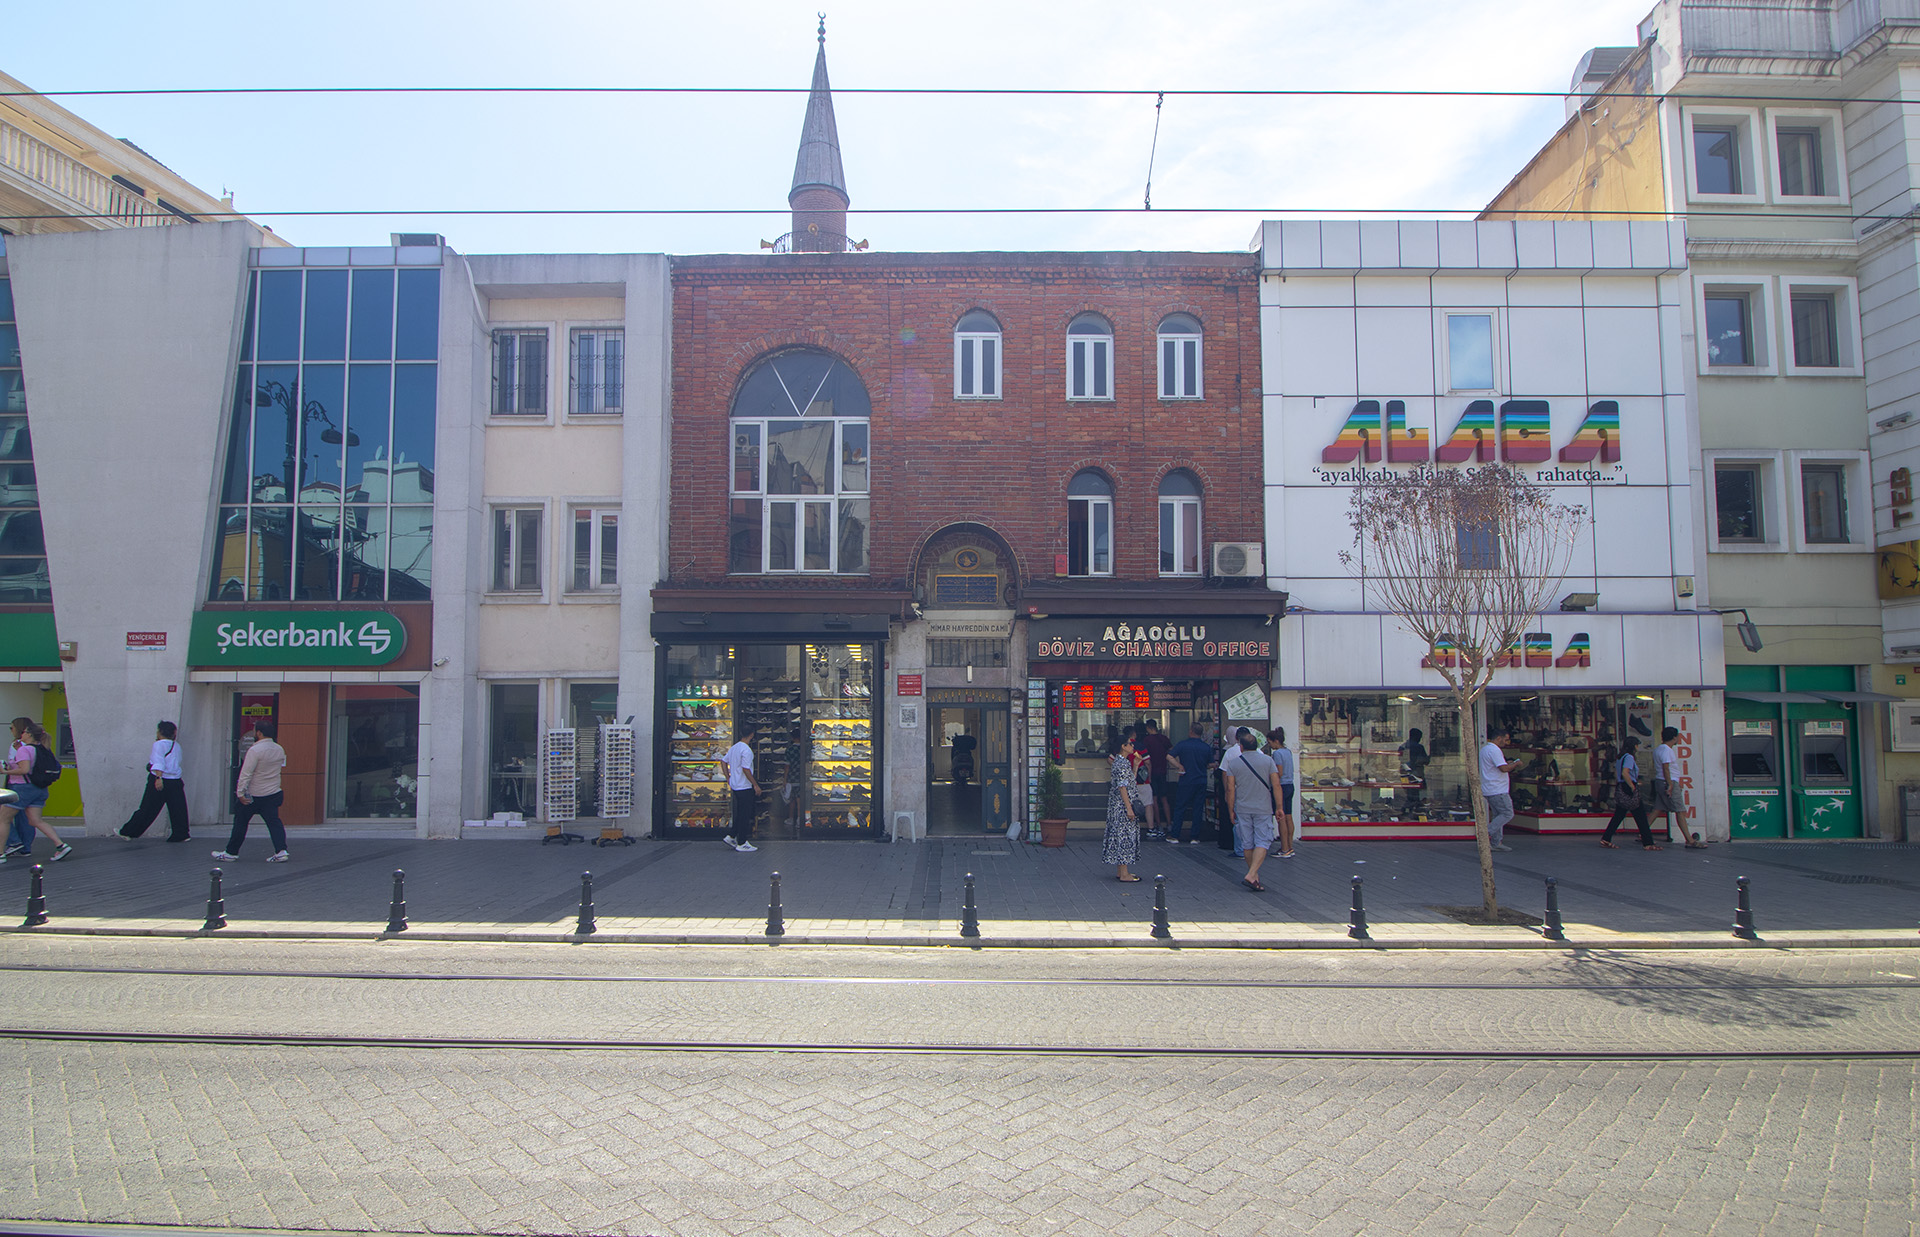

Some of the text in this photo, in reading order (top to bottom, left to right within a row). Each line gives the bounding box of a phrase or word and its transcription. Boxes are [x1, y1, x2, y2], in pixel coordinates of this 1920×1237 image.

[128, 633, 165, 641] YENİÇERİLER
[217, 622, 353, 654] Şekerbank
[1103, 622, 1206, 641] AĞAOĞLU
[1038, 637, 1095, 656] DÖVİZ
[1112, 641, 1194, 656] CHANGE
[1203, 641, 1270, 656] OFFICE
